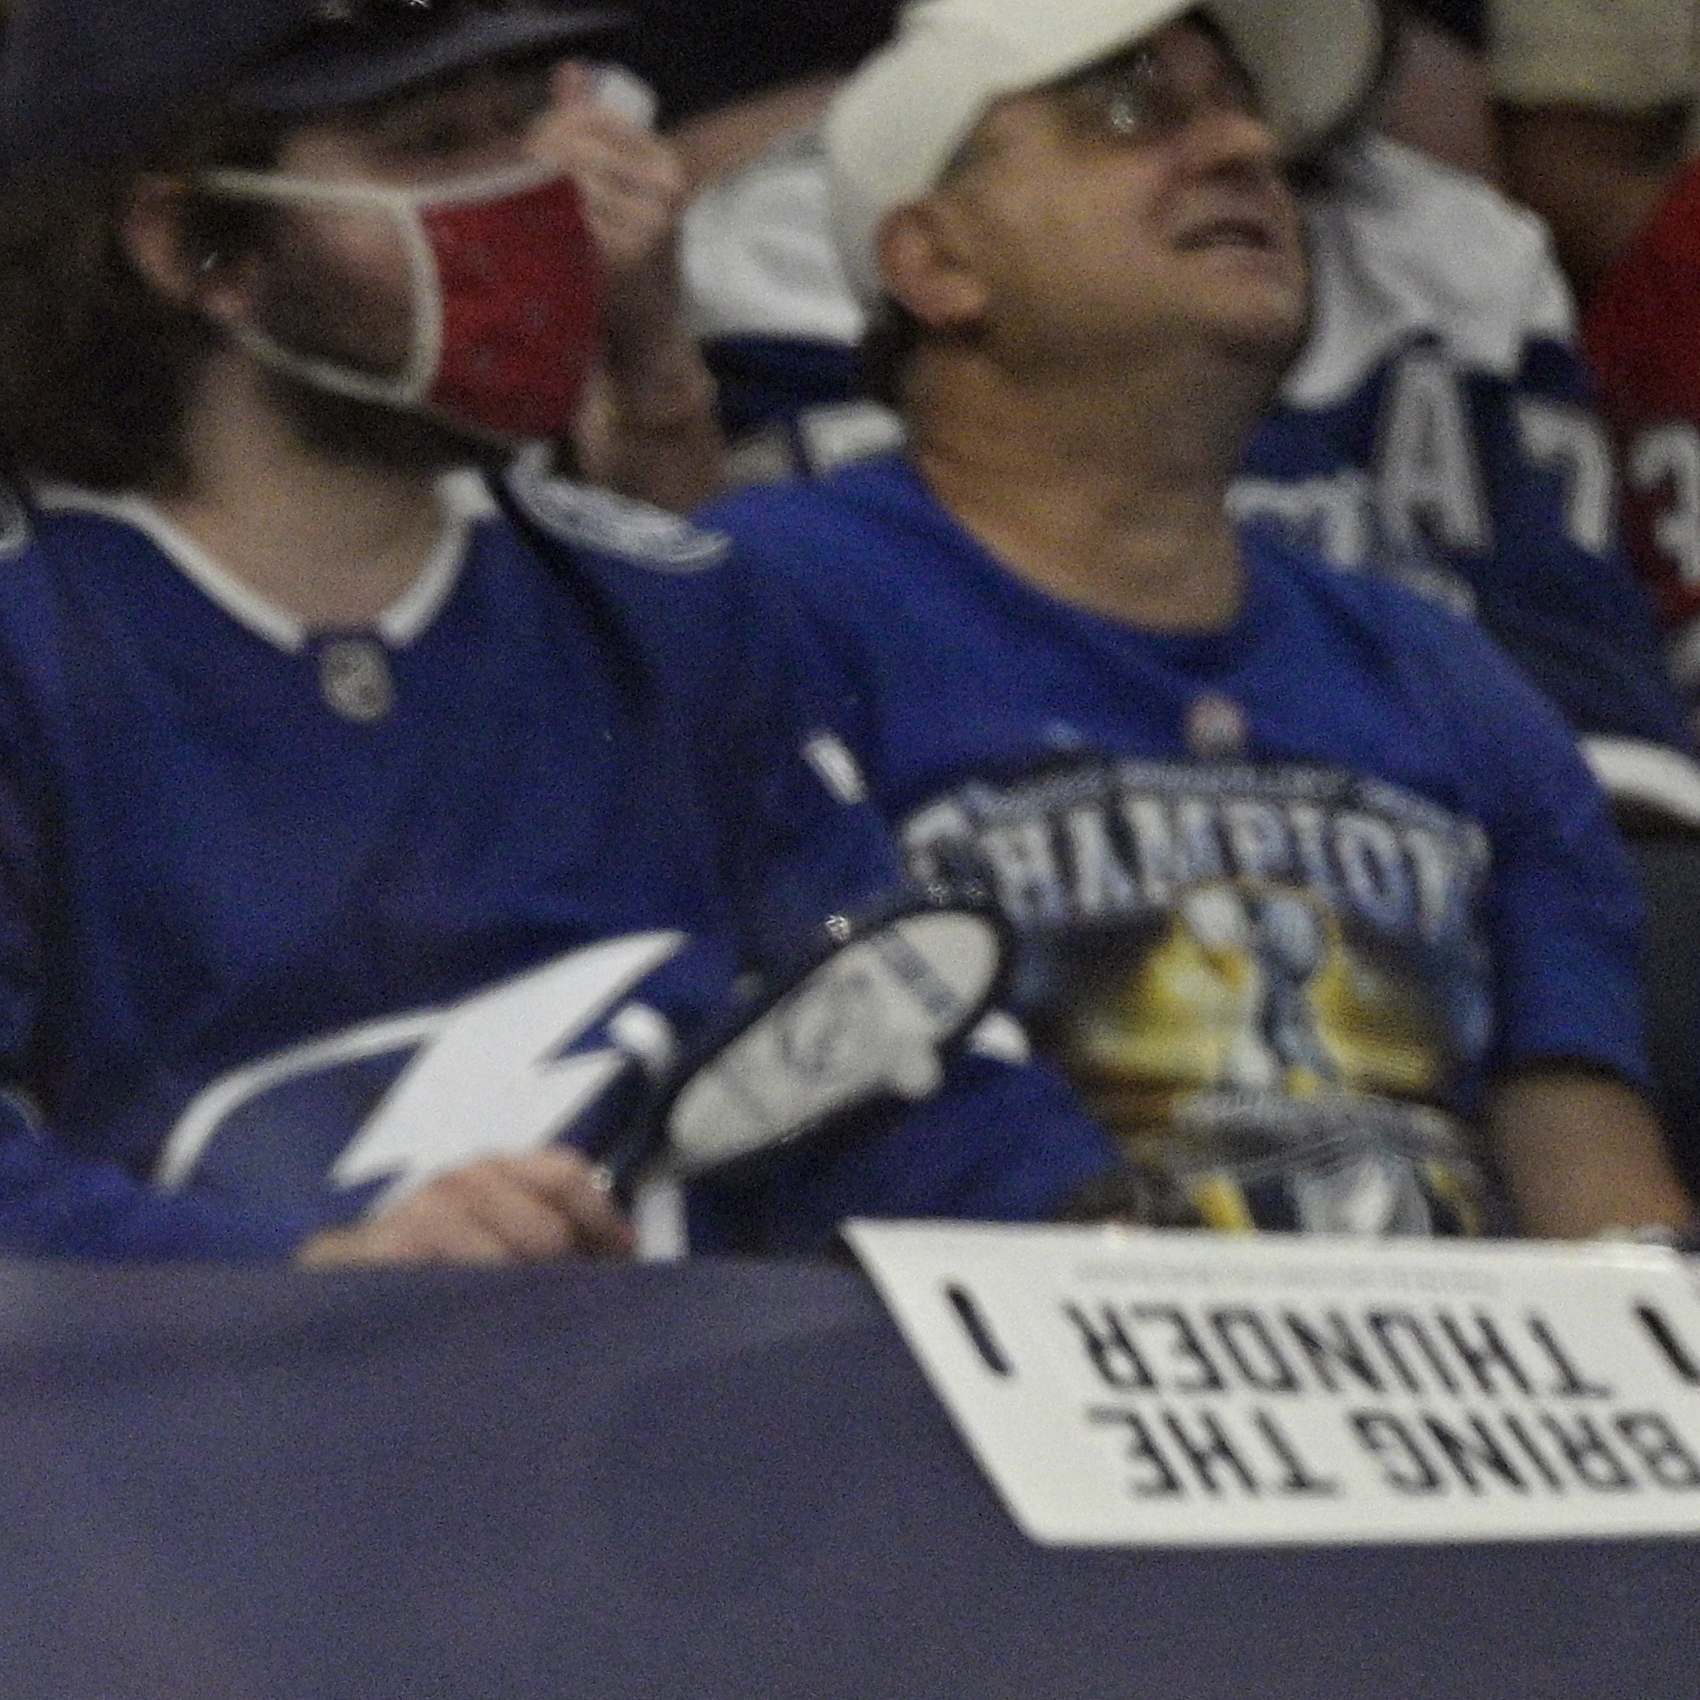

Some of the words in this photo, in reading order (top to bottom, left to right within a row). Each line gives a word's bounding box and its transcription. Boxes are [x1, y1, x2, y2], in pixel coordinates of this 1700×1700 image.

[1062, 1302, 1612, 1400] THUNDER
[1088, 1406, 1338, 1498] THE
[1353, 1406, 1700, 1493] BRING
